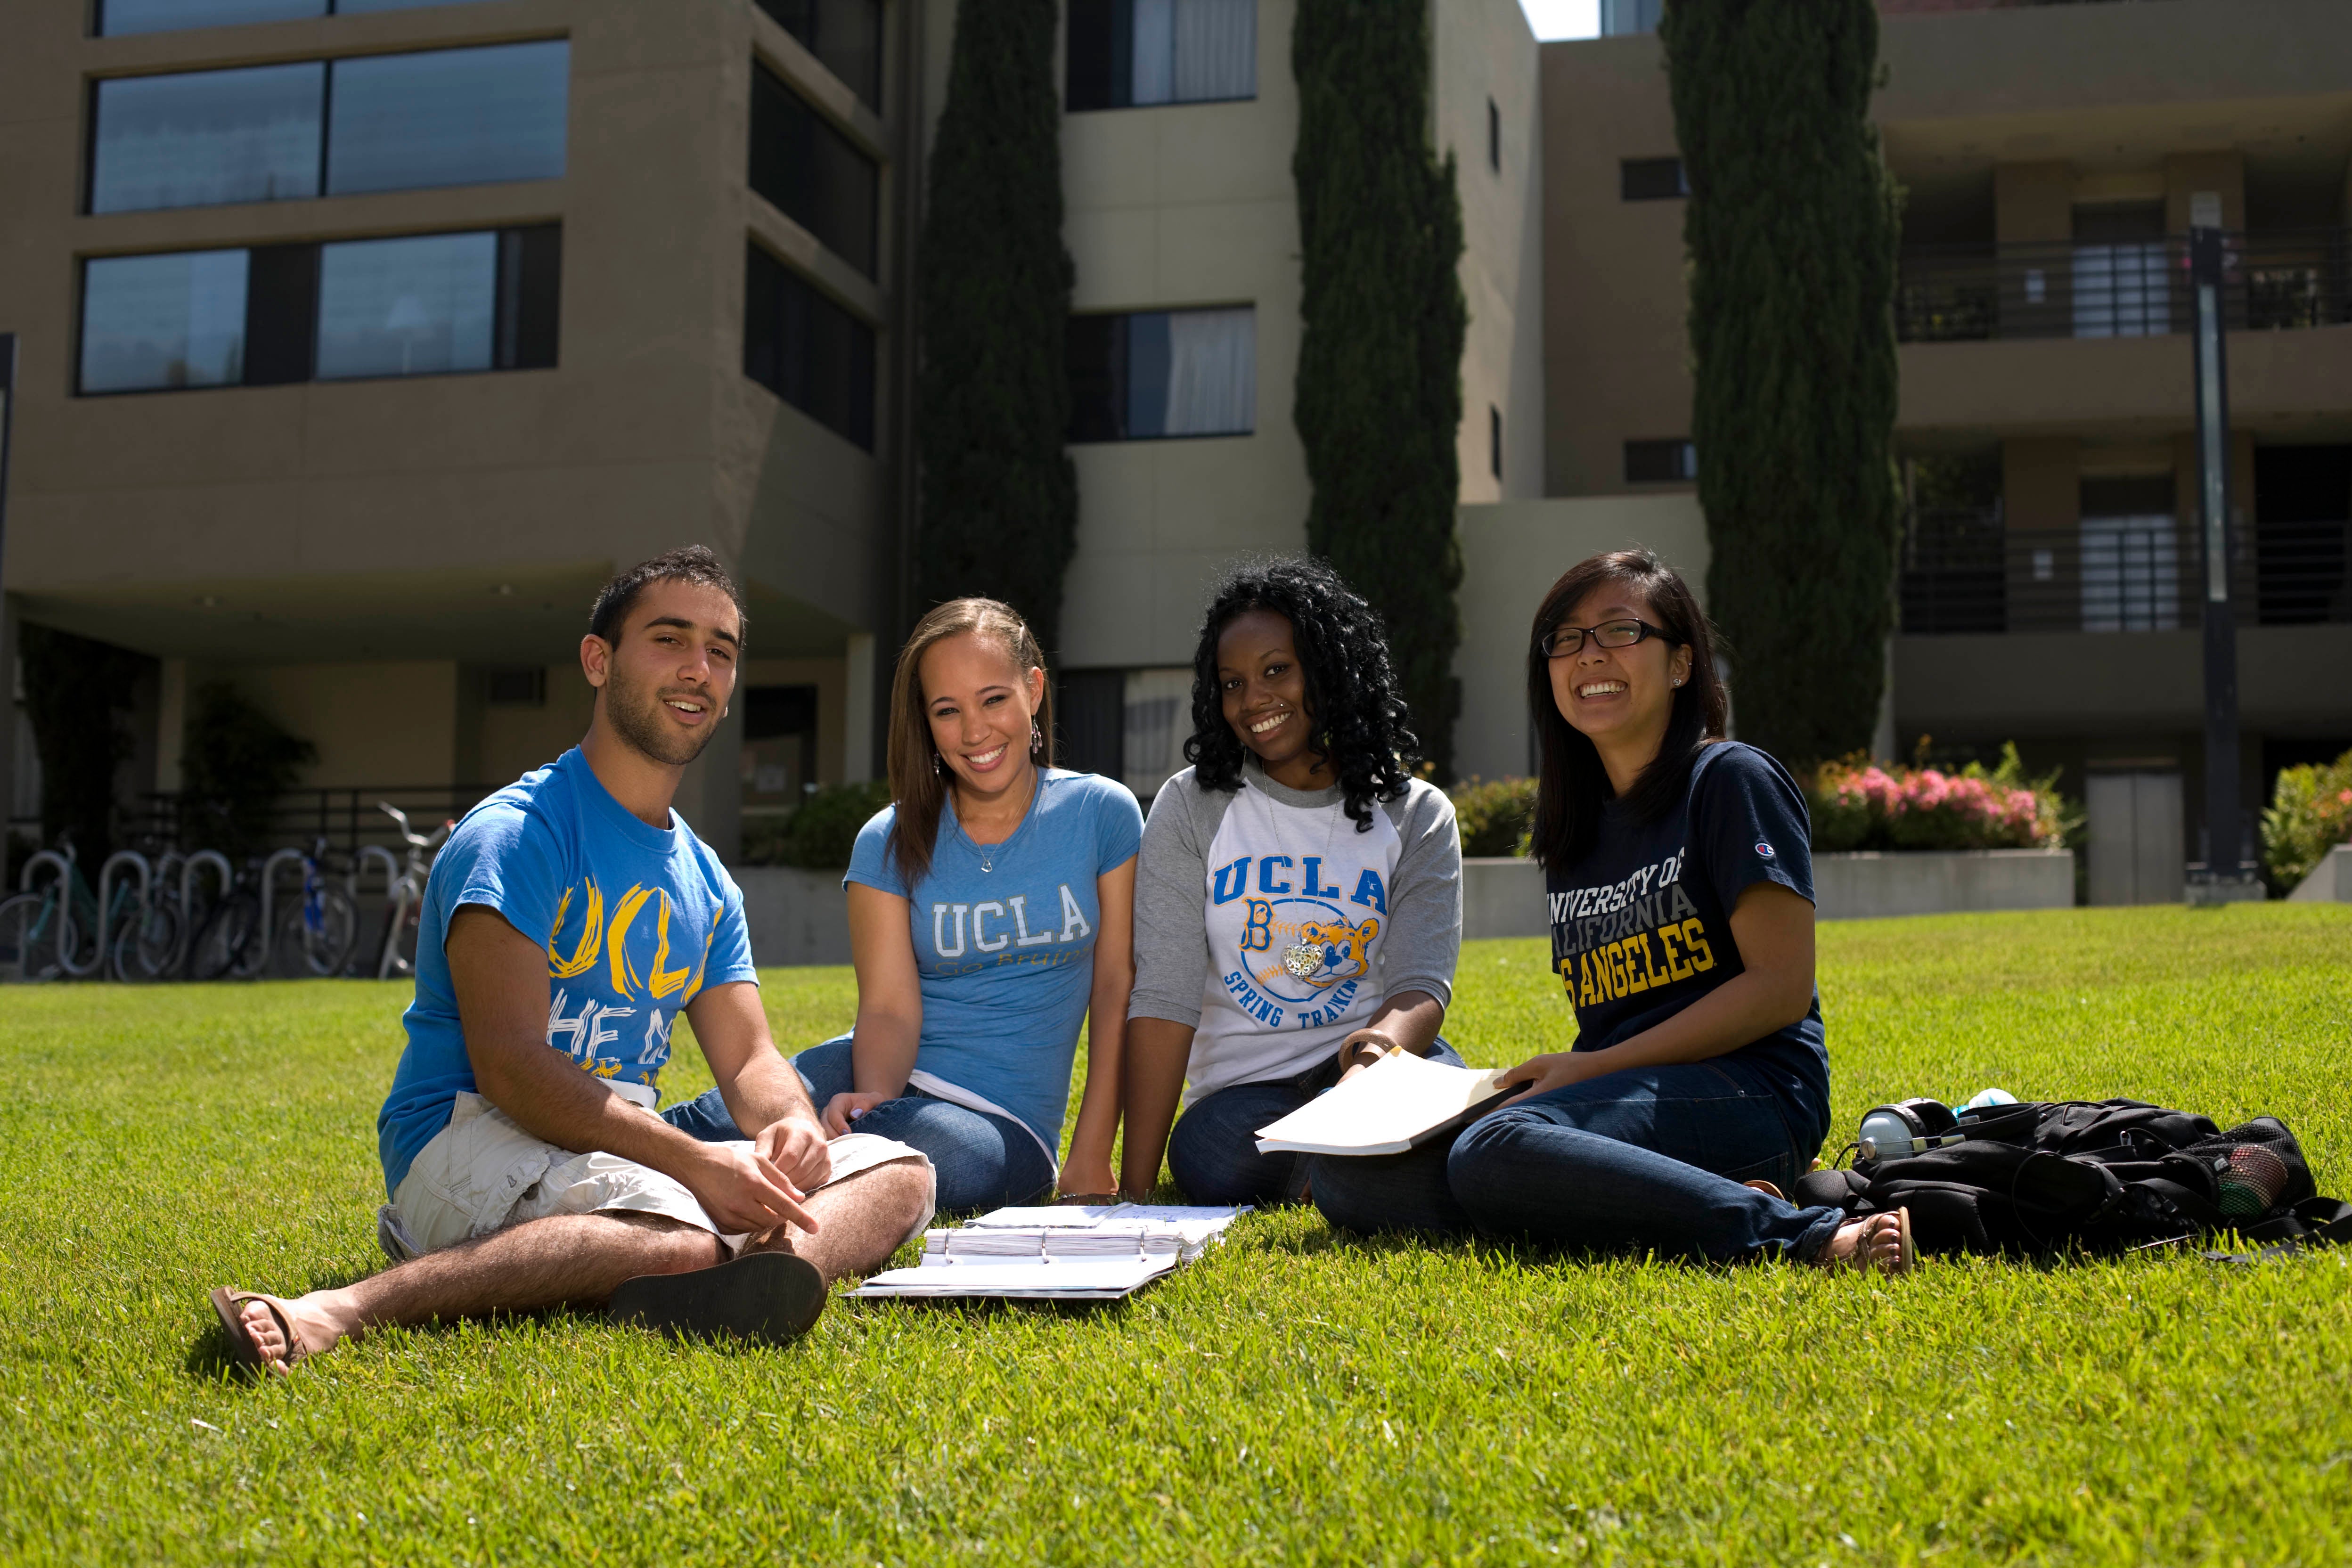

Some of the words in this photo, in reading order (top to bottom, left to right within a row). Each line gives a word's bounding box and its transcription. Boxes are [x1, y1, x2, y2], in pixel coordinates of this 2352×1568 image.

[932, 884, 1091, 958] UCLA
[1211, 854, 1388, 920] UCLA
[1547, 864, 1658, 925] NIVERSITY
[1658, 846, 1685, 888] OF
[1553, 883, 1699, 958] ALIFORNIA
[1238, 897, 1276, 953] B
[1580, 917, 1714, 1007] ANGELES
[935, 962, 983, 975] Go
[1225, 971, 1283, 1028] SPRING
[1298, 980, 1358, 1029] TRAININ
[546, 988, 637, 1063] HE
